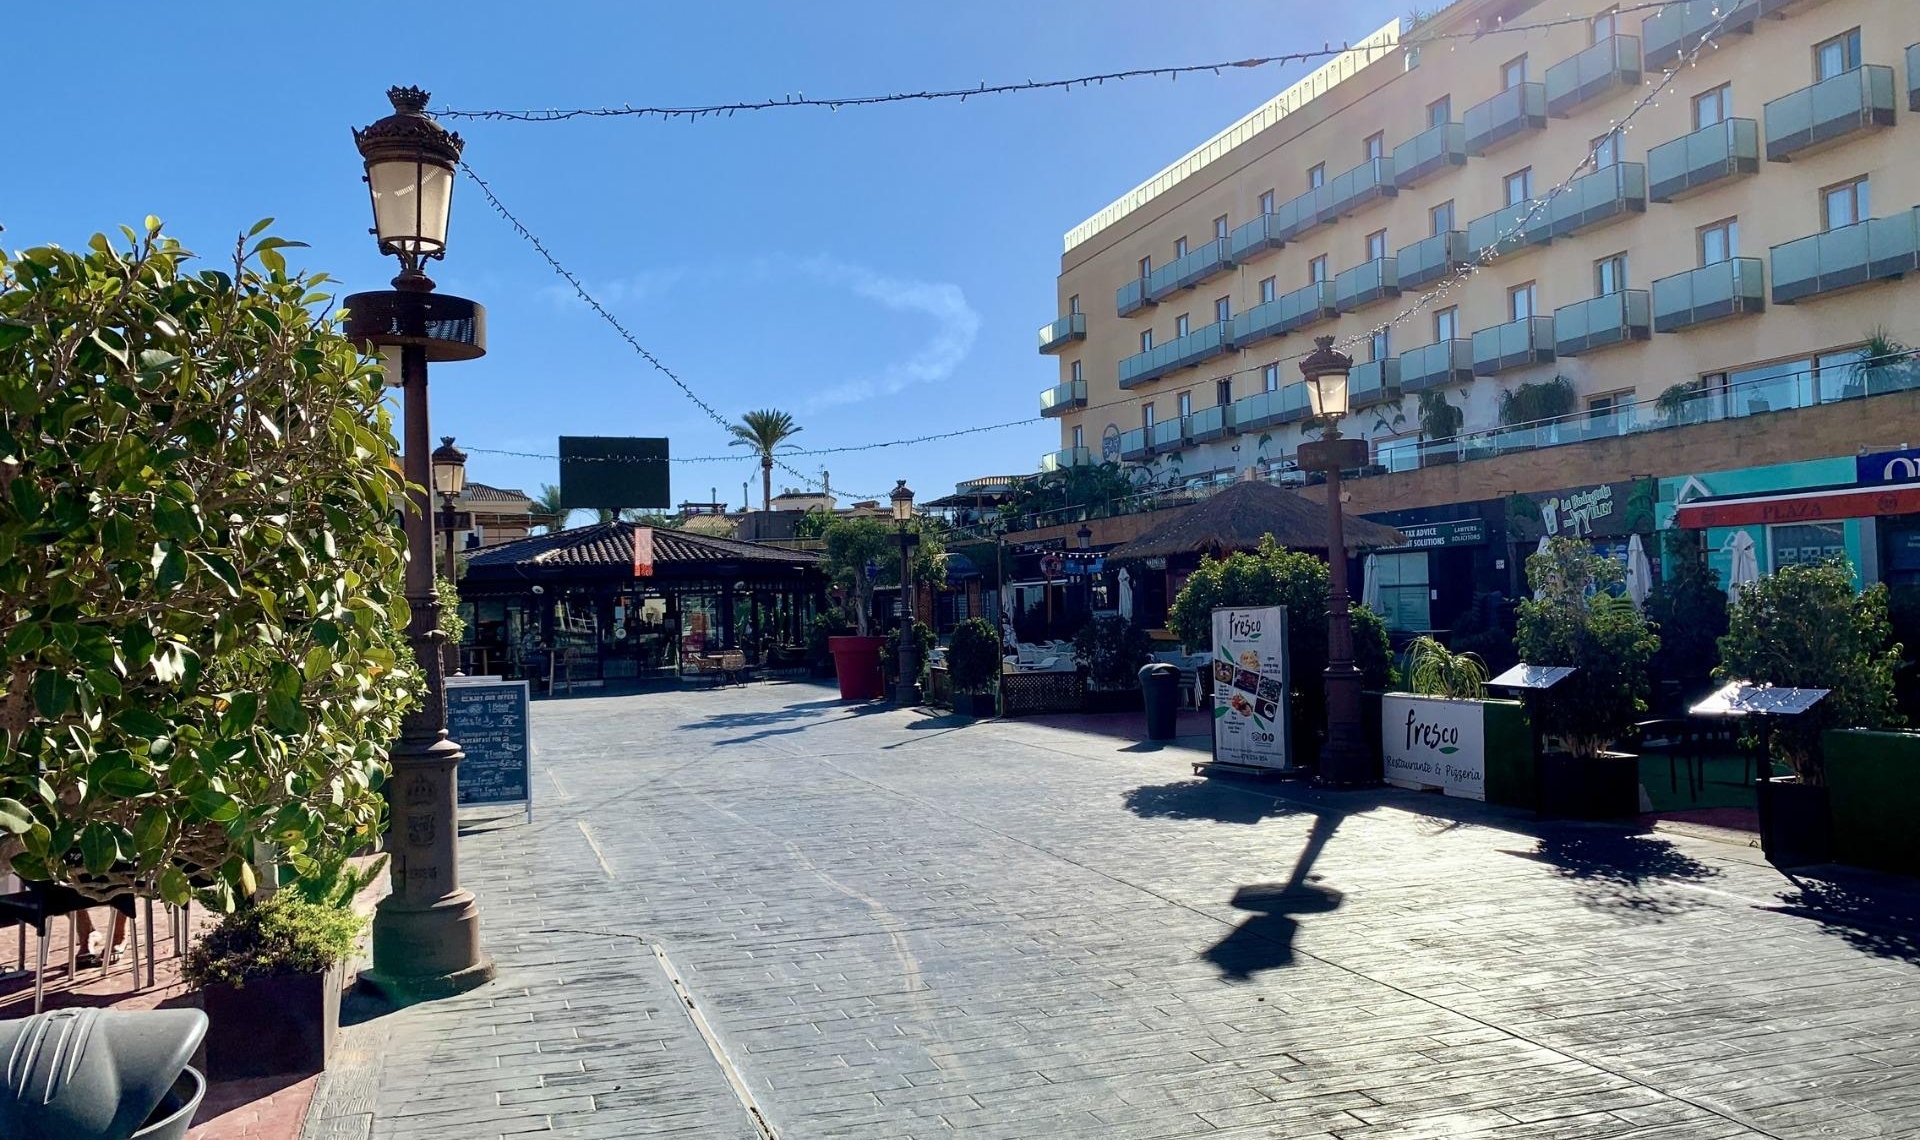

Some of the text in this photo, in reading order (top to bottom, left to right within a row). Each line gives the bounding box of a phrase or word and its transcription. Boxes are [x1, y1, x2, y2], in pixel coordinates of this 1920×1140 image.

[1762, 503, 1823, 521] PLAZA
[1405, 527, 1437, 537] TAX ADVICE
[1414, 537, 1445, 547] SOLUTIONS
[1229, 611, 1261, 640] fresco
[1405, 708, 1459, 750] fresco
[1385, 755, 1432, 773] Restaurante
[1434, 762, 1441, 776] &
